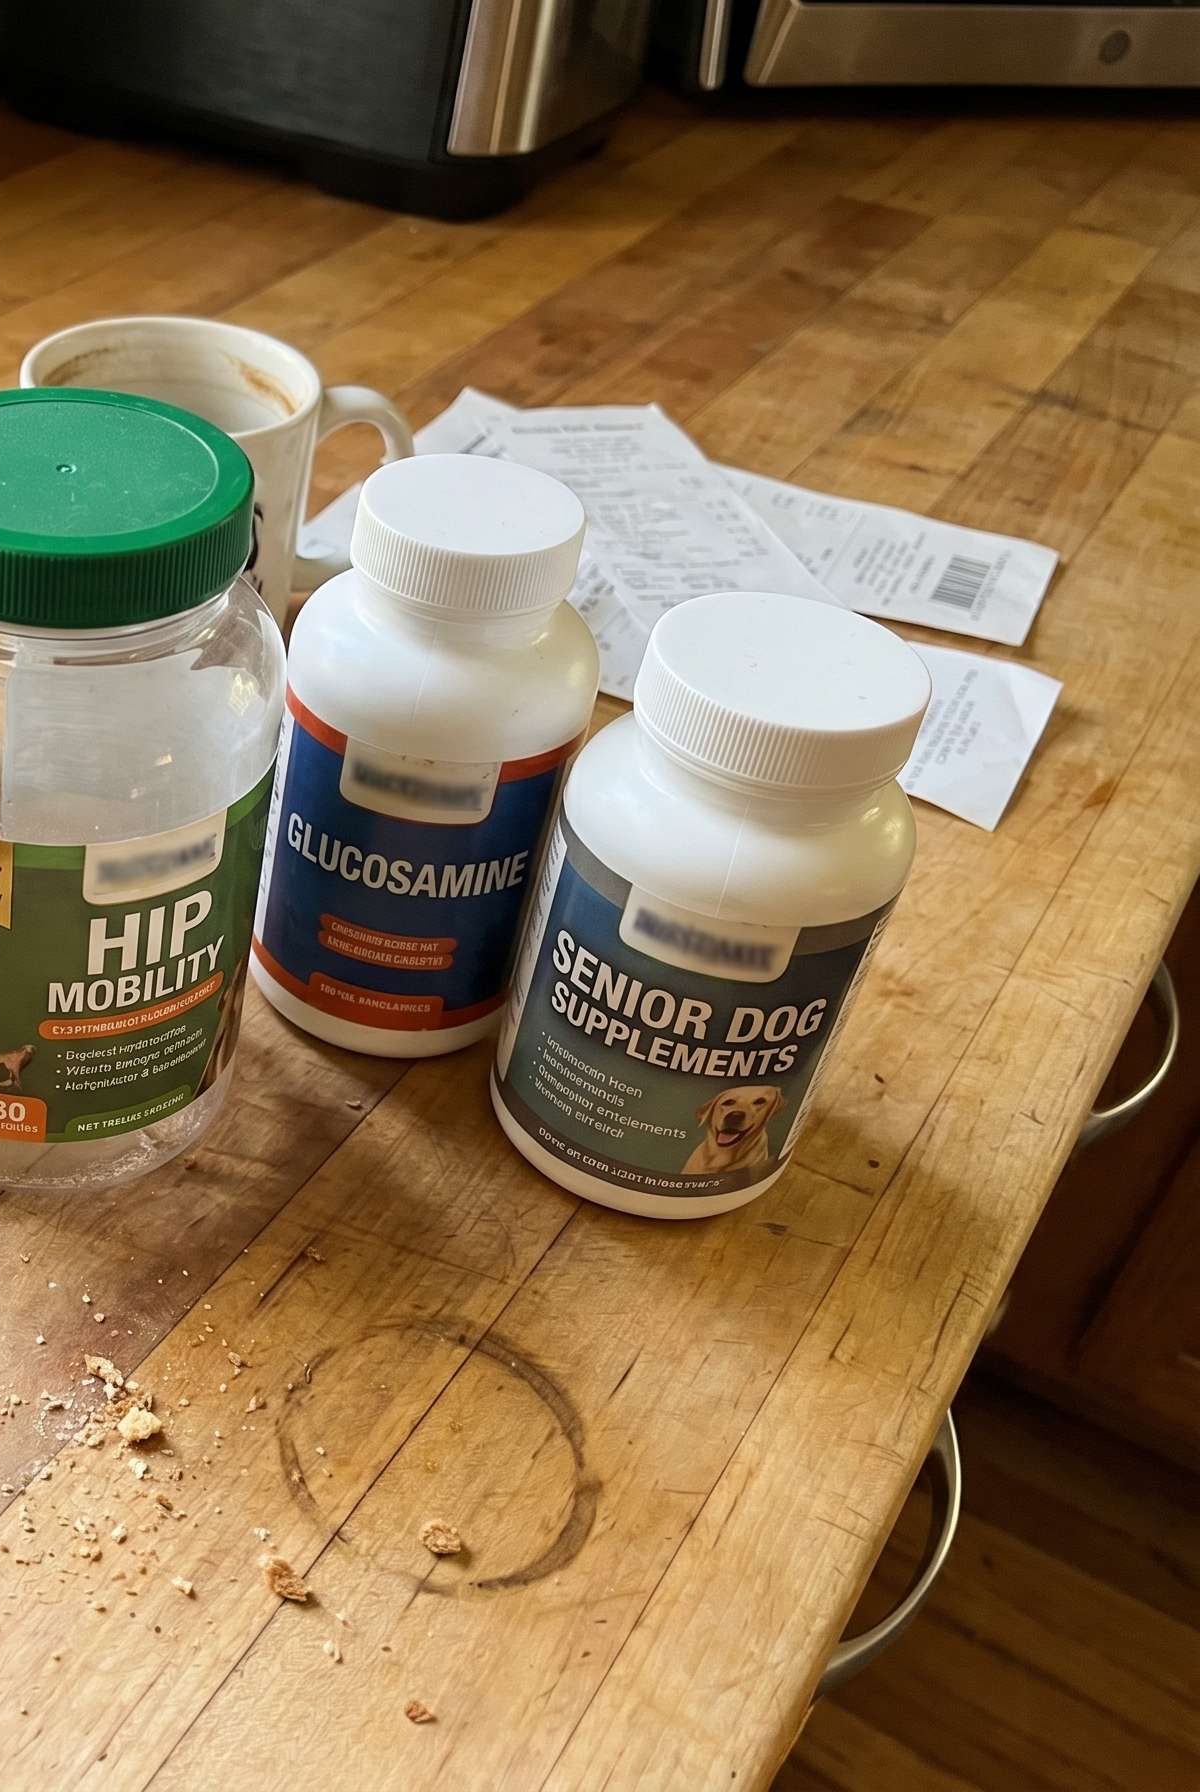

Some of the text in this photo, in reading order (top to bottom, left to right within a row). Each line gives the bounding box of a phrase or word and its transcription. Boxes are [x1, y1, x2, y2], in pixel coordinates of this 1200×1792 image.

[287, 812, 529, 899] GLUCOSAMINE
[47, 934, 225, 1013] MOBILITY
[87, 890, 213, 976] HIP
[551, 929, 713, 1040] SENIOR
[725, 998, 827, 1043] DOG
[551, 981, 798, 1077] SUPPLEMENTS
[77, 1121, 100, 1132] NET
